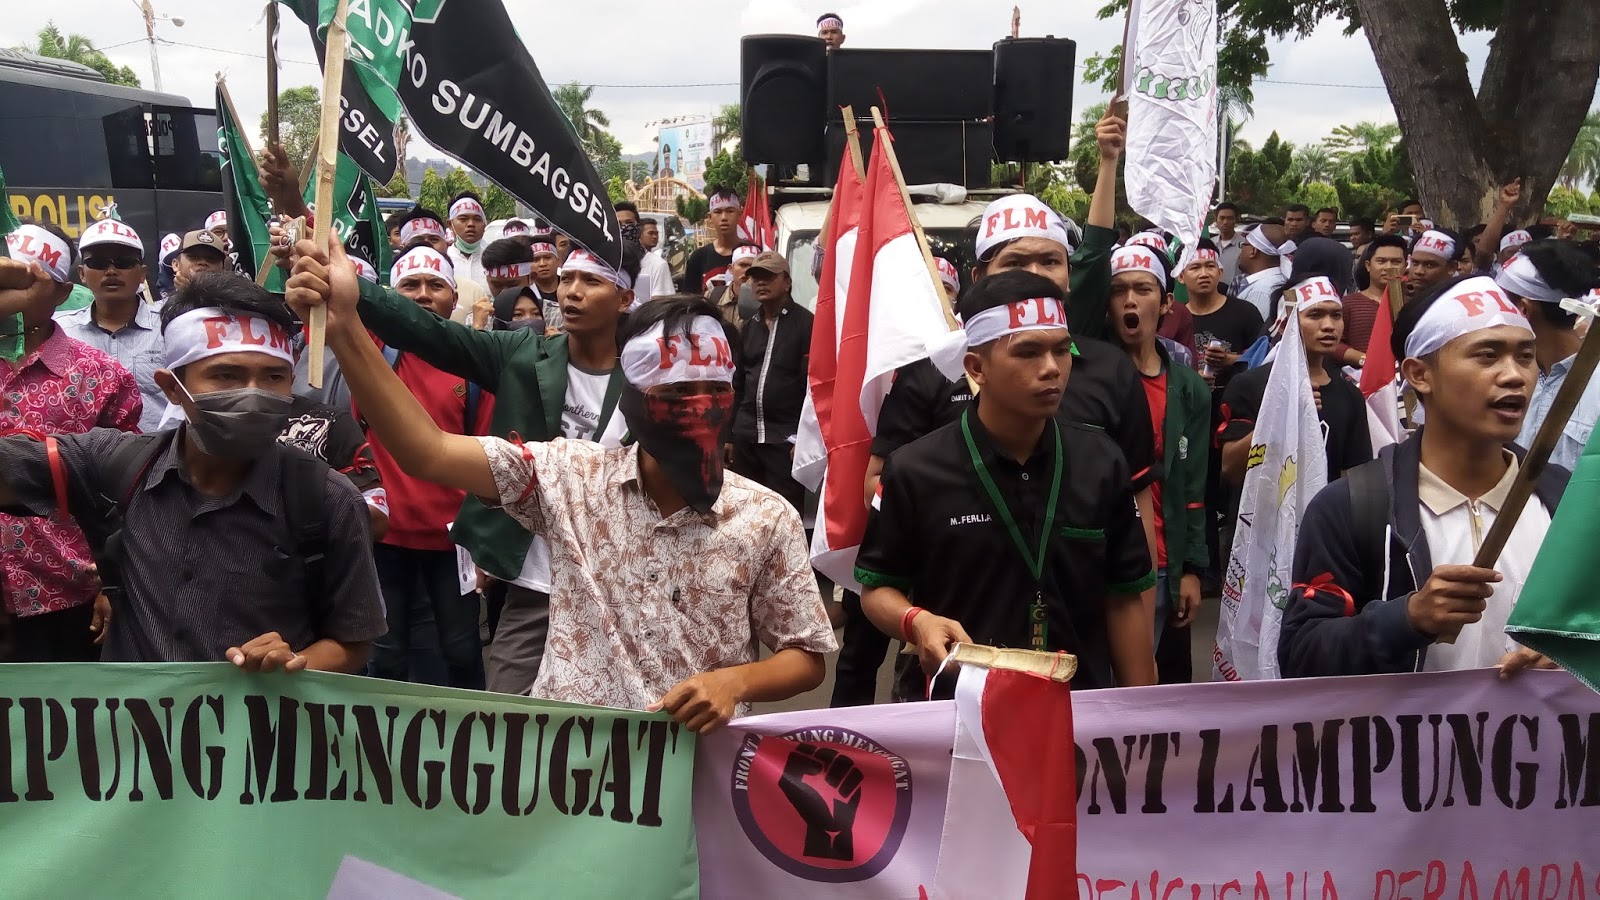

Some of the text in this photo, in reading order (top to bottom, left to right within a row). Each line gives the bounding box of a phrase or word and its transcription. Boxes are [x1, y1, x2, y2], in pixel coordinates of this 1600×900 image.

[432, 80, 613, 242] SUMBAGSEL
[9, 194, 115, 238] POLIS
[456, 202, 480, 212] FLM
[97, 222, 138, 240] FLM
[411, 217, 441, 232] FLM
[985, 208, 1048, 238] FLM
[1509, 233, 1532, 243] FLM
[1416, 235, 1447, 251] FLM
[395, 255, 441, 277] FLM
[202, 315, 291, 352] FLM
[656, 334, 734, 370] FLM
[563, 404, 600, 421] orthern
[240, 695, 680, 827] MENGGUGAT
[735, 737, 758, 791] FRONT
[1194, 711, 1540, 813] LAMPUNG
